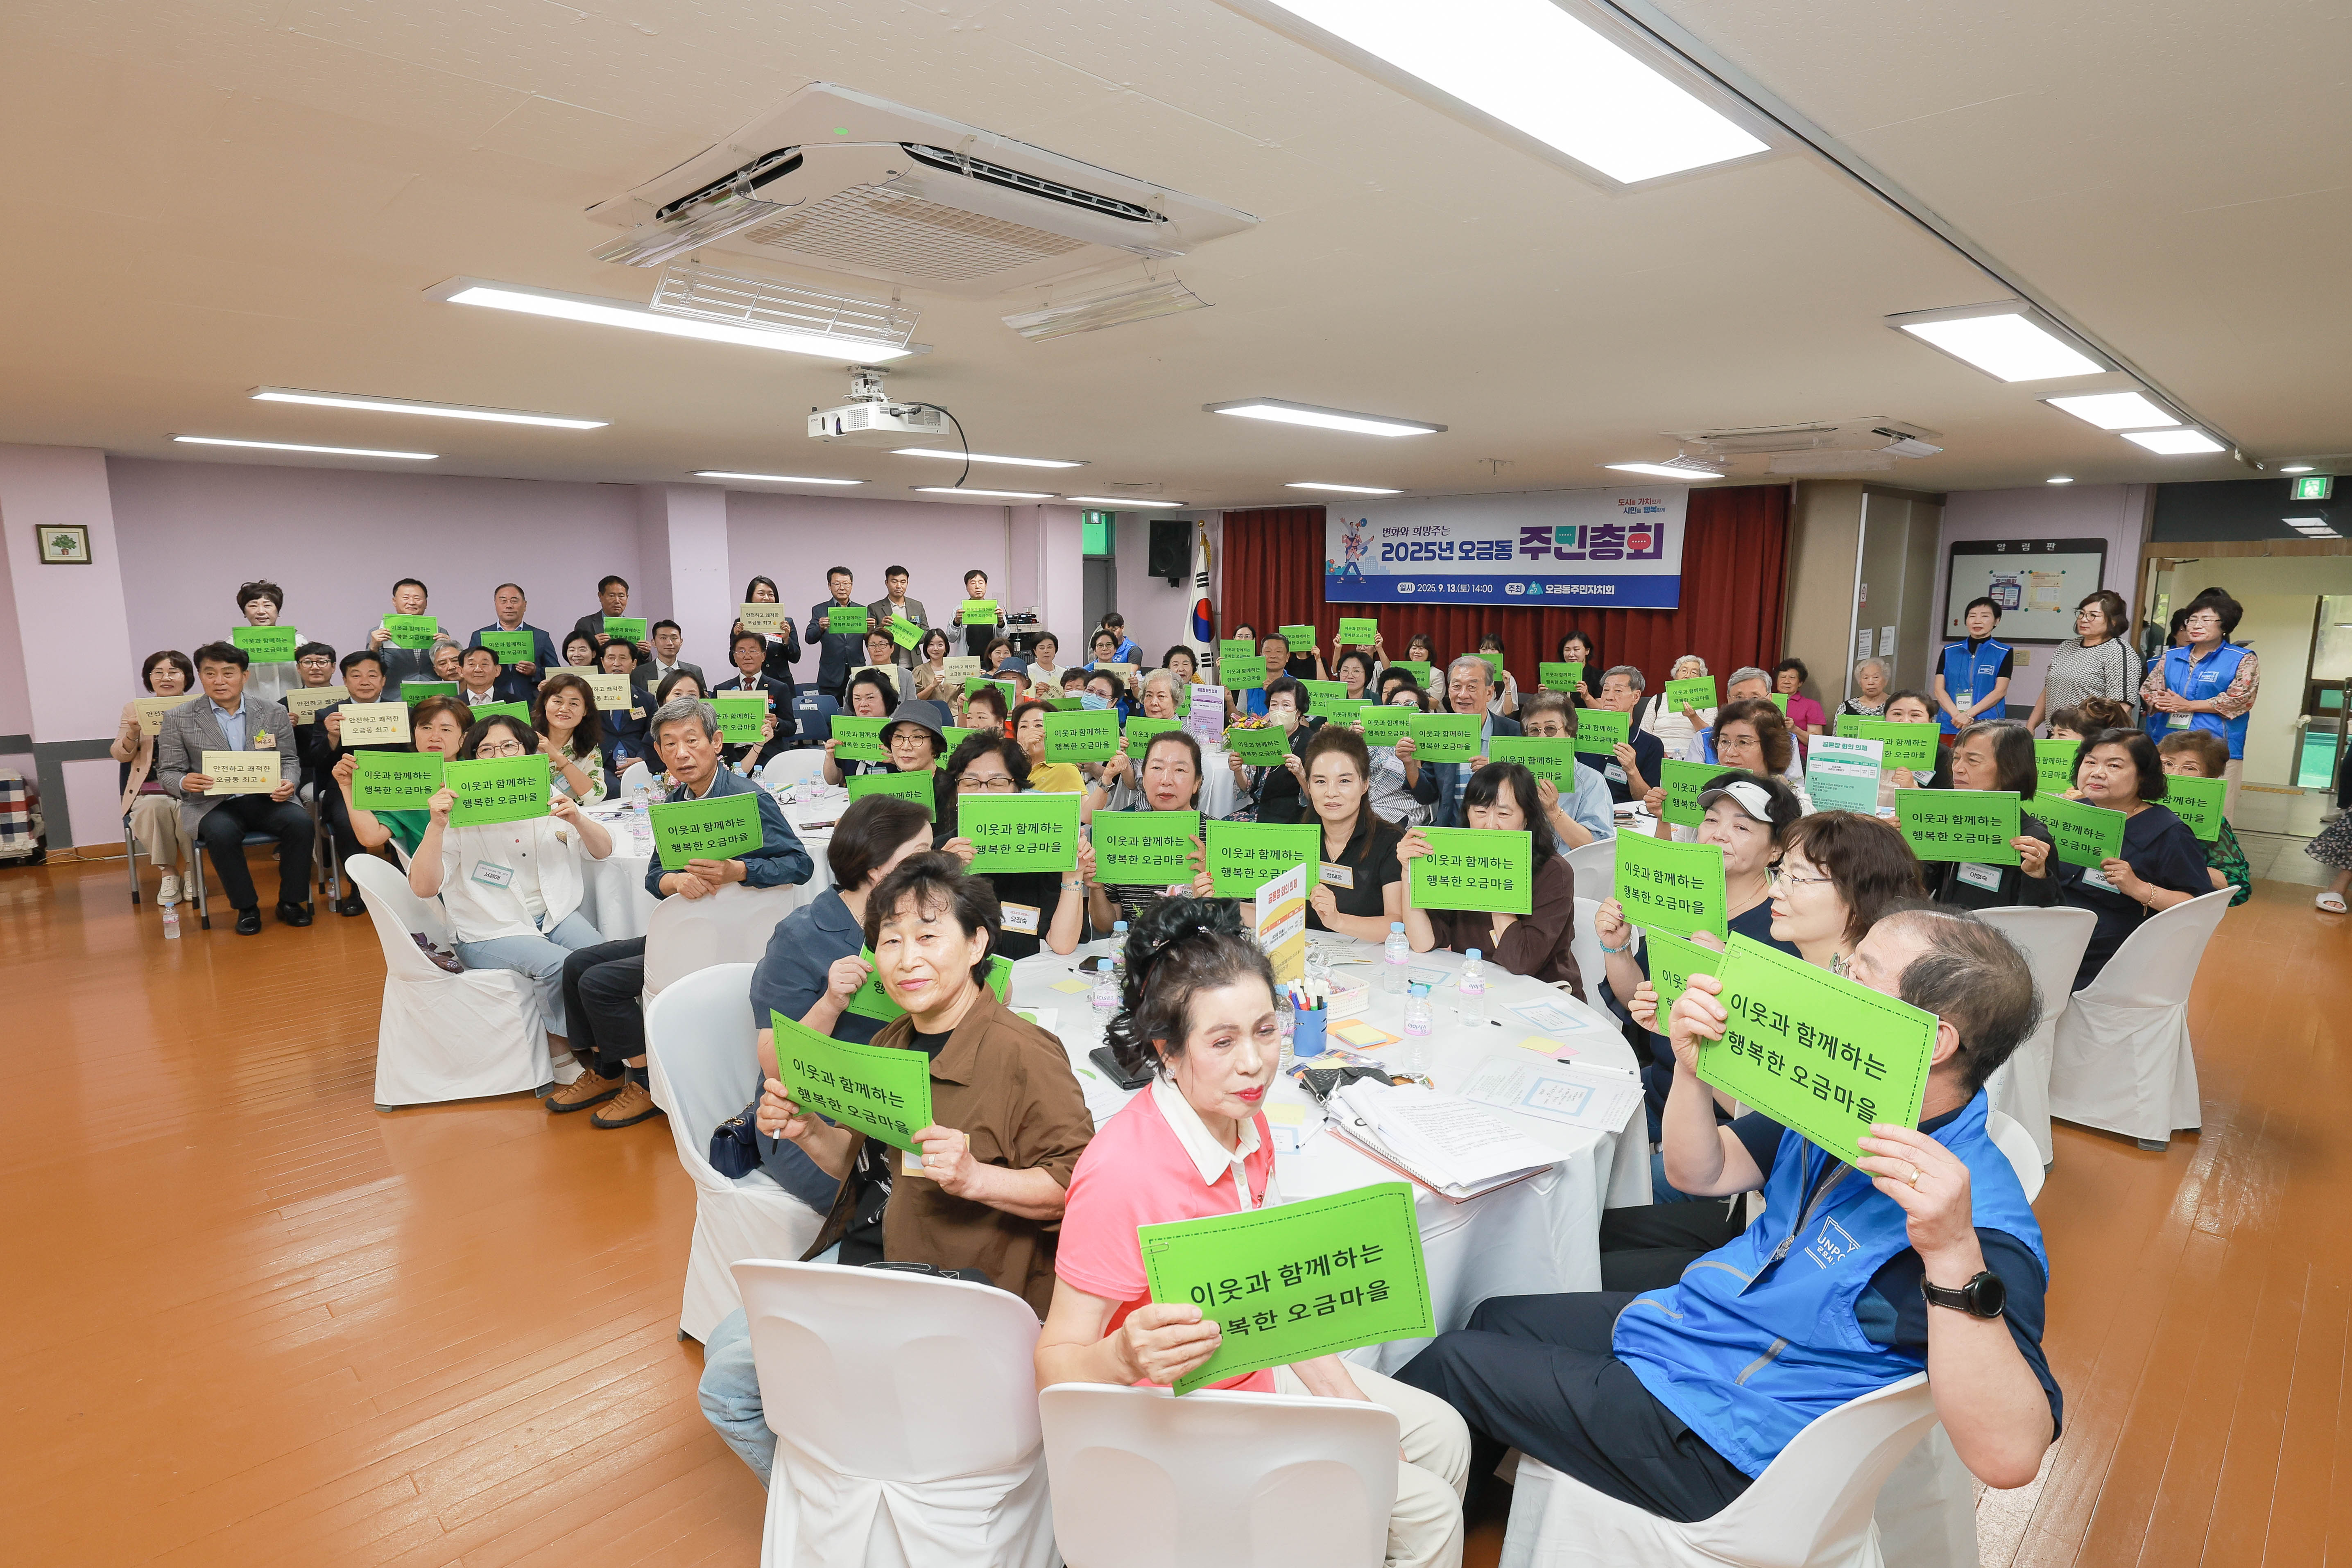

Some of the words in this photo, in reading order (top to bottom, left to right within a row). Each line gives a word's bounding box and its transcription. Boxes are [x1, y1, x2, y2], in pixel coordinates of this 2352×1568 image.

[1382, 527, 1410, 538] 변화와
[1412, 525, 1451, 536] 희망주는
[1381, 541, 1454, 561] 2025년
[1458, 540, 1513, 561] 오금동
[1519, 523, 1664, 560] 주민총회
[1417, 584, 1437, 592] 2025.
[1438, 584, 1445, 592] 9.
[1472, 584, 1493, 593] 14:00
[1508, 584, 1522, 593] 주최
[1545, 584, 1615, 595] 오금동주민자치회
[1055, 729, 1077, 737] 이웃과
[1528, 757, 1562, 765] 함께하는
[2043, 757, 2068, 765] 함께하는
[365, 771, 391, 780] 이웃과
[393, 772, 431, 780] 함께하는
[364, 786, 392, 794] 행복한
[461, 781, 493, 791] 이웃과
[496, 777, 536, 788] 함께하는
[1673, 782, 1698, 794] 이웃과
[462, 797, 494, 808] 행복한
[498, 793, 537, 804] 오금마을
[1673, 798, 1697, 810] 행복한
[2162, 793, 2207, 807] 함께하는
[668, 824, 700, 835] 이웃과
[703, 818, 745, 832] 함께하는
[1913, 813, 1948, 824] 이웃과
[1952, 815, 2002, 826] 함께하는
[976, 824, 1012, 835] 이웃과
[1016, 823, 1063, 834] 함께하는
[2062, 822, 2105, 840] 함께하는
[671, 841, 703, 852] 행복한
[707, 835, 748, 848] 오금마을
[1107, 836, 1139, 846] 이웃과
[1142, 836, 1184, 846] 함께하는
[1913, 830, 1948, 841] 행복한
[1953, 833, 2002, 844] 오금마을
[976, 844, 1011, 854] 행복한
[1015, 842, 1062, 853] 오금마을
[1222, 848, 1255, 859] 이웃과
[1259, 849, 1304, 860] 함께하는
[2059, 839, 2102, 856] 오금마을
[1107, 854, 1139, 864] 행복한
[1142, 855, 1184, 865] 오금마을
[1425, 853, 1462, 867] 이웃과
[1466, 856, 1513, 869] 함께하는
[484, 871, 501, 880] 서정애
[1221, 867, 1255, 878] 행복한
[1327, 872, 1342, 880] 정혜윤
[1625, 862, 1650, 880] 이웃과
[1653, 870, 1704, 889] 함께하는
[1970, 872, 1988, 881] 이영숙
[1427, 875, 1462, 887] 행복한
[1466, 878, 1514, 890] 오금마을
[1268, 889, 1280, 904] 공론장
[1281, 883, 1289, 897] 회의
[1290, 878, 1297, 891] 의제
[1624, 885, 1650, 904] 행복한
[1655, 895, 1705, 914] 오금마을
[1731, 994, 1790, 1036] 이웃과
[1797, 1022, 1886, 1080] 함께하는
[794, 1059, 835, 1087] 이웃과
[839, 1077, 904, 1108] 함께하는
[1729, 1031, 1785, 1076] 행복한
[1790, 1066, 1877, 1125] 오금마을
[797, 1087, 842, 1113] 행복한
[848, 1106, 909, 1135] 오금마을
[1191, 1271, 1270, 1306] 이웃과
[1278, 1245, 1383, 1287] 함께하는
[1288, 1280, 1389, 1322] 오금마을
